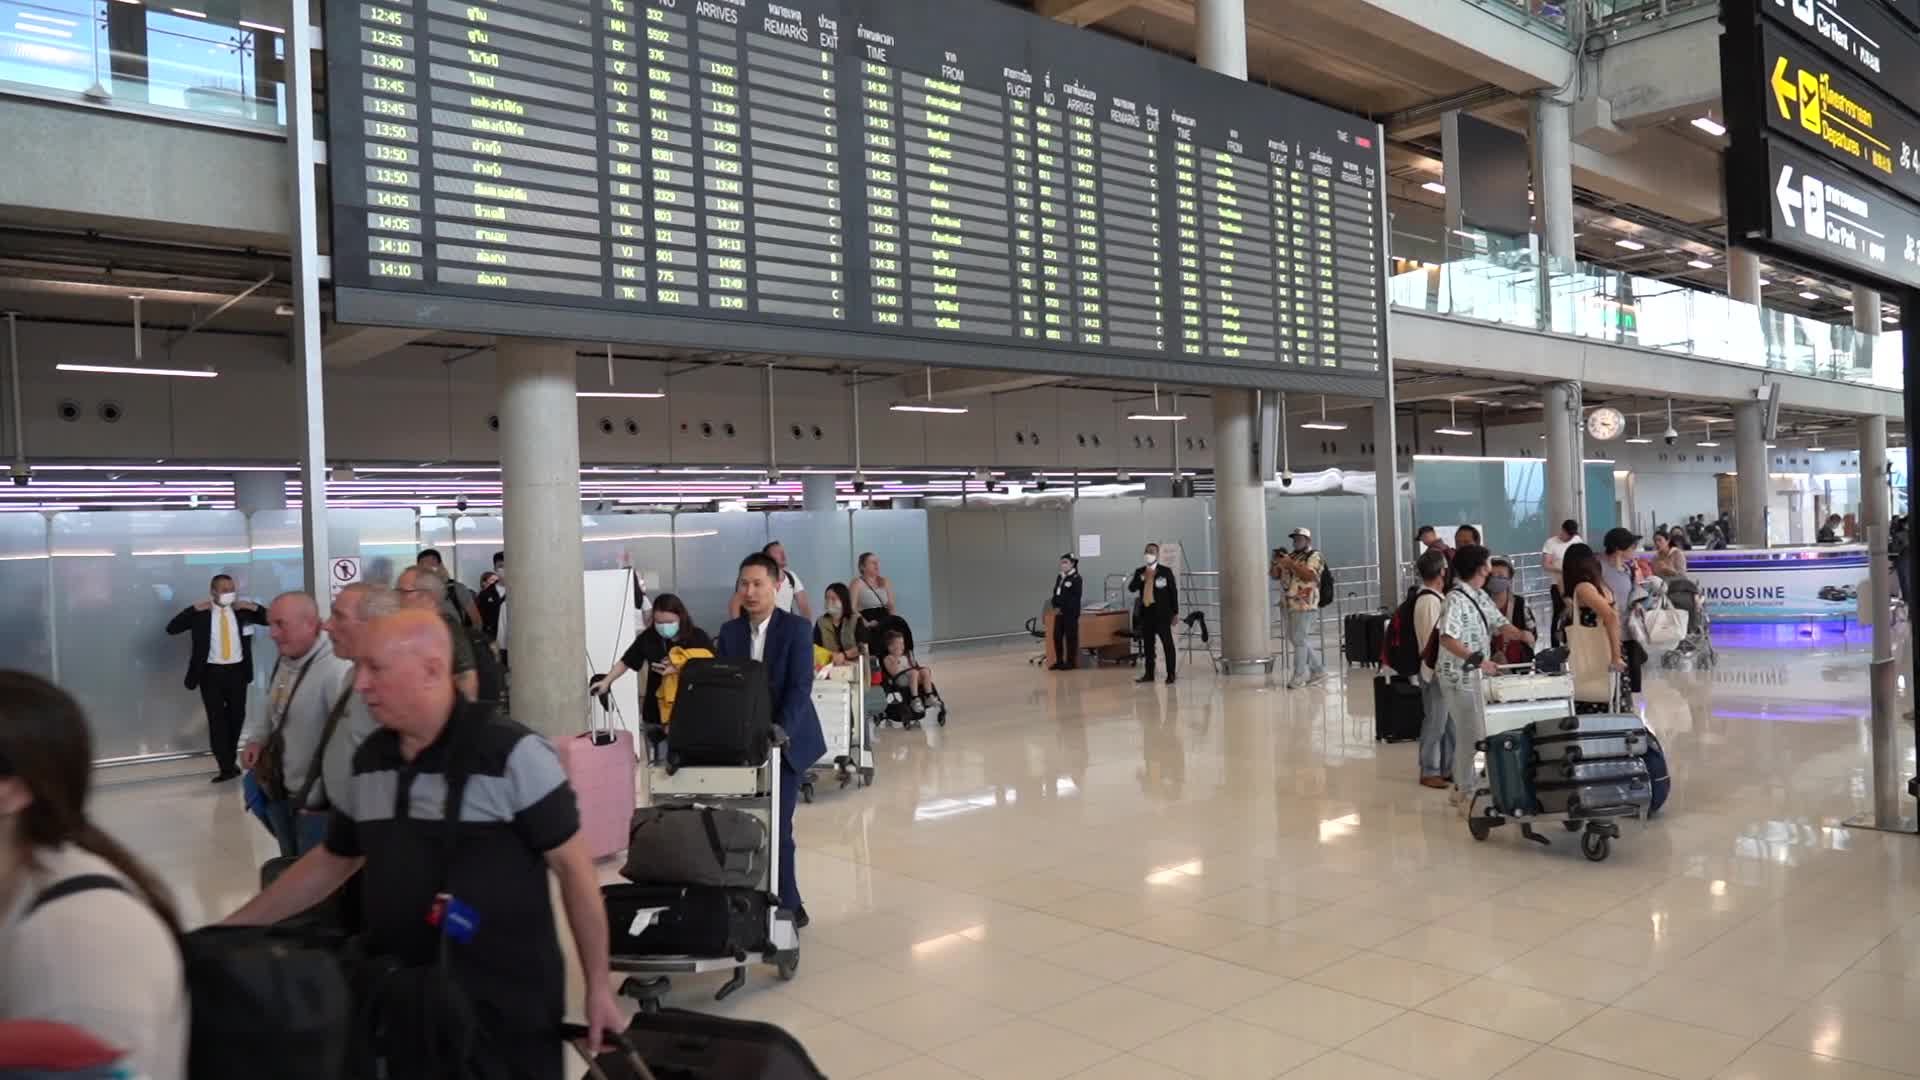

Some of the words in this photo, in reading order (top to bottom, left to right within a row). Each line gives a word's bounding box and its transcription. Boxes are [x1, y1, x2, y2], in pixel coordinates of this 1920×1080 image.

[611, 0, 624, 12] TG
[647, 8, 663, 21] 332
[696, 2, 738, 24] ARRIVES
[764, 18, 808, 42] REMARKS
[820, 33, 838, 49] EXIT
[1817, 13, 1830, 38] Car
[371, 8, 402, 24] 12:45
[712, 83, 734, 96] 13:02
[372, 31, 402, 47] 12:55
[614, 82, 627, 96] KQ
[648, 48, 665, 61] 376
[712, 63, 733, 76] 13:02
[373, 54, 403, 70] 13:40
[651, 108, 667, 121] 741
[866, 45, 887, 62] TIME
[942, 65, 964, 81] FROM
[1006, 81, 1031, 99] FLIGHT
[1043, 92, 1055, 105] NO
[1067, 98, 1095, 116] ARRIVES
[1110, 109, 1140, 128] REMARKS
[374, 77, 404, 93] 13:45
[616, 122, 629, 133] TG
[651, 128, 668, 141] 923
[375, 100, 405, 115] 13:45
[376, 124, 406, 138] 13:50
[1822, 120, 1860, 156] Departures
[376, 147, 407, 161] 13:50
[377, 170, 408, 184] 13:50
[873, 187, 891, 199] 14:25
[378, 193, 409, 207] 14:05
[656, 231, 672, 241] 121
[874, 205, 892, 216] 14:25
[379, 217, 409, 230] 14:05
[656, 250, 672, 262] 901
[875, 224, 893, 234] 14:25
[1827, 222, 1840, 244] Car
[1840, 227, 1856, 250] Park
[379, 240, 410, 253] 14:10
[658, 271, 674, 281] 775
[380, 263, 411, 276] 14:10
[658, 290, 679, 302] 9221
[1702, 586, 1784, 599] IMOUSINE
